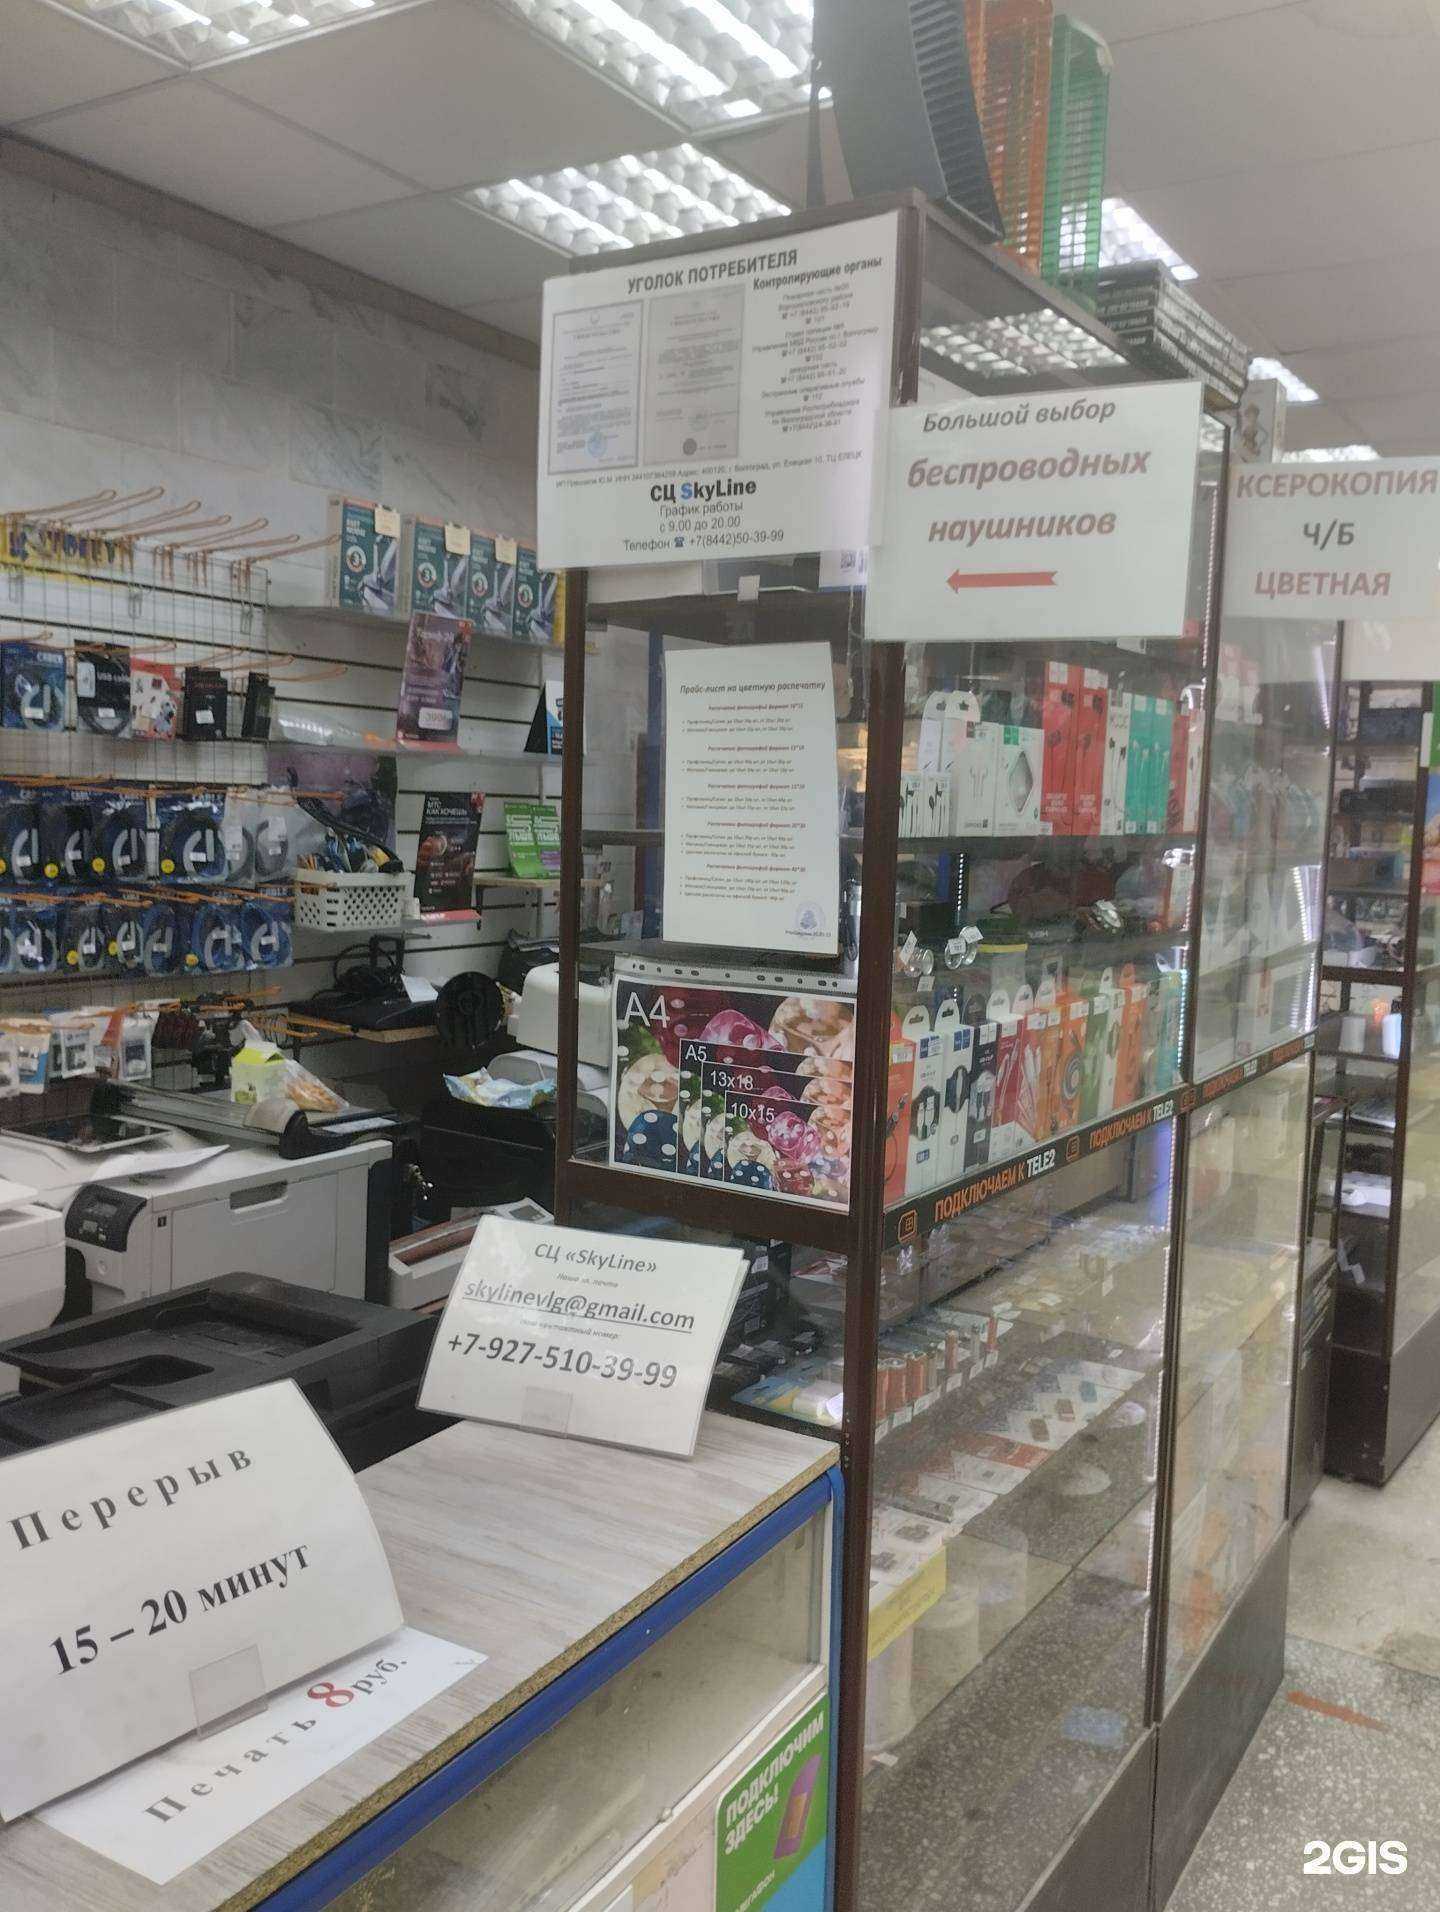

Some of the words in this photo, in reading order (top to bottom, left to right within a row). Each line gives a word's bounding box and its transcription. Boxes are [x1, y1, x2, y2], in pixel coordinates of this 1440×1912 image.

[628, 267, 684, 295] УГОЛОК
[687, 249, 799, 285] ПОТРЕБИТЕЛЯ
[752, 265, 842, 291] Контролирующие
[843, 256, 883, 275] органы
[922, 405, 1029, 433] Большой
[1034, 398, 1116, 425] выбор
[907, 447, 1151, 491] беспроводных
[1236, 468, 1438, 500] КСЕРОКОПИЯ
[650, 483, 677, 504] СЦ
[680, 478, 758, 504] SkyLine
[659, 503, 700, 518] График
[702, 500, 744, 516] работы
[694, 519, 708, 531] до
[711, 515, 741, 530] 20.00
[623, 537, 671, 554] Телефон
[689, 529, 785, 548] +7(8442)50-39-99
[928, 510, 1117, 549] наушников
[1302, 520, 1355, 550] Ч/Б
[1254, 570, 1391, 600] ЦВЕТНАЯ
[624, 991, 671, 1029] A4
[684, 1043, 708, 1063] A5
[710, 1069, 755, 1092] 13x18
[730, 1102, 776, 1124] 10x15
[1088, 1115, 1145, 1150] ПОДКЛЮЧАЕМ
[1152, 1099, 1175, 1122] TELE2
[933, 1168, 1016, 1224] ПОДКЛЮЧАЕМ
[1016, 1164, 1025, 1183] К
[1026, 1148, 1056, 1179] TELE2
[534, 1242, 561, 1264] СЦ
[565, 1247, 658, 1274] «SkyLine»
[463, 1279, 696, 1331] skylinevlg@gmail.com
[448, 1332, 678, 1389] +7-927-510-39-99
[8, 1448, 252, 1551] Перерыв
[49, 1624, 100, 1676] 15
[140, 1588, 189, 1637] 20
[196, 1543, 313, 1613] минут
[141, 1716, 318, 1825] Печать
[306, 1680, 356, 1709] 8
[725, 1710, 825, 1829] ПОДКЛЮЧИМ
